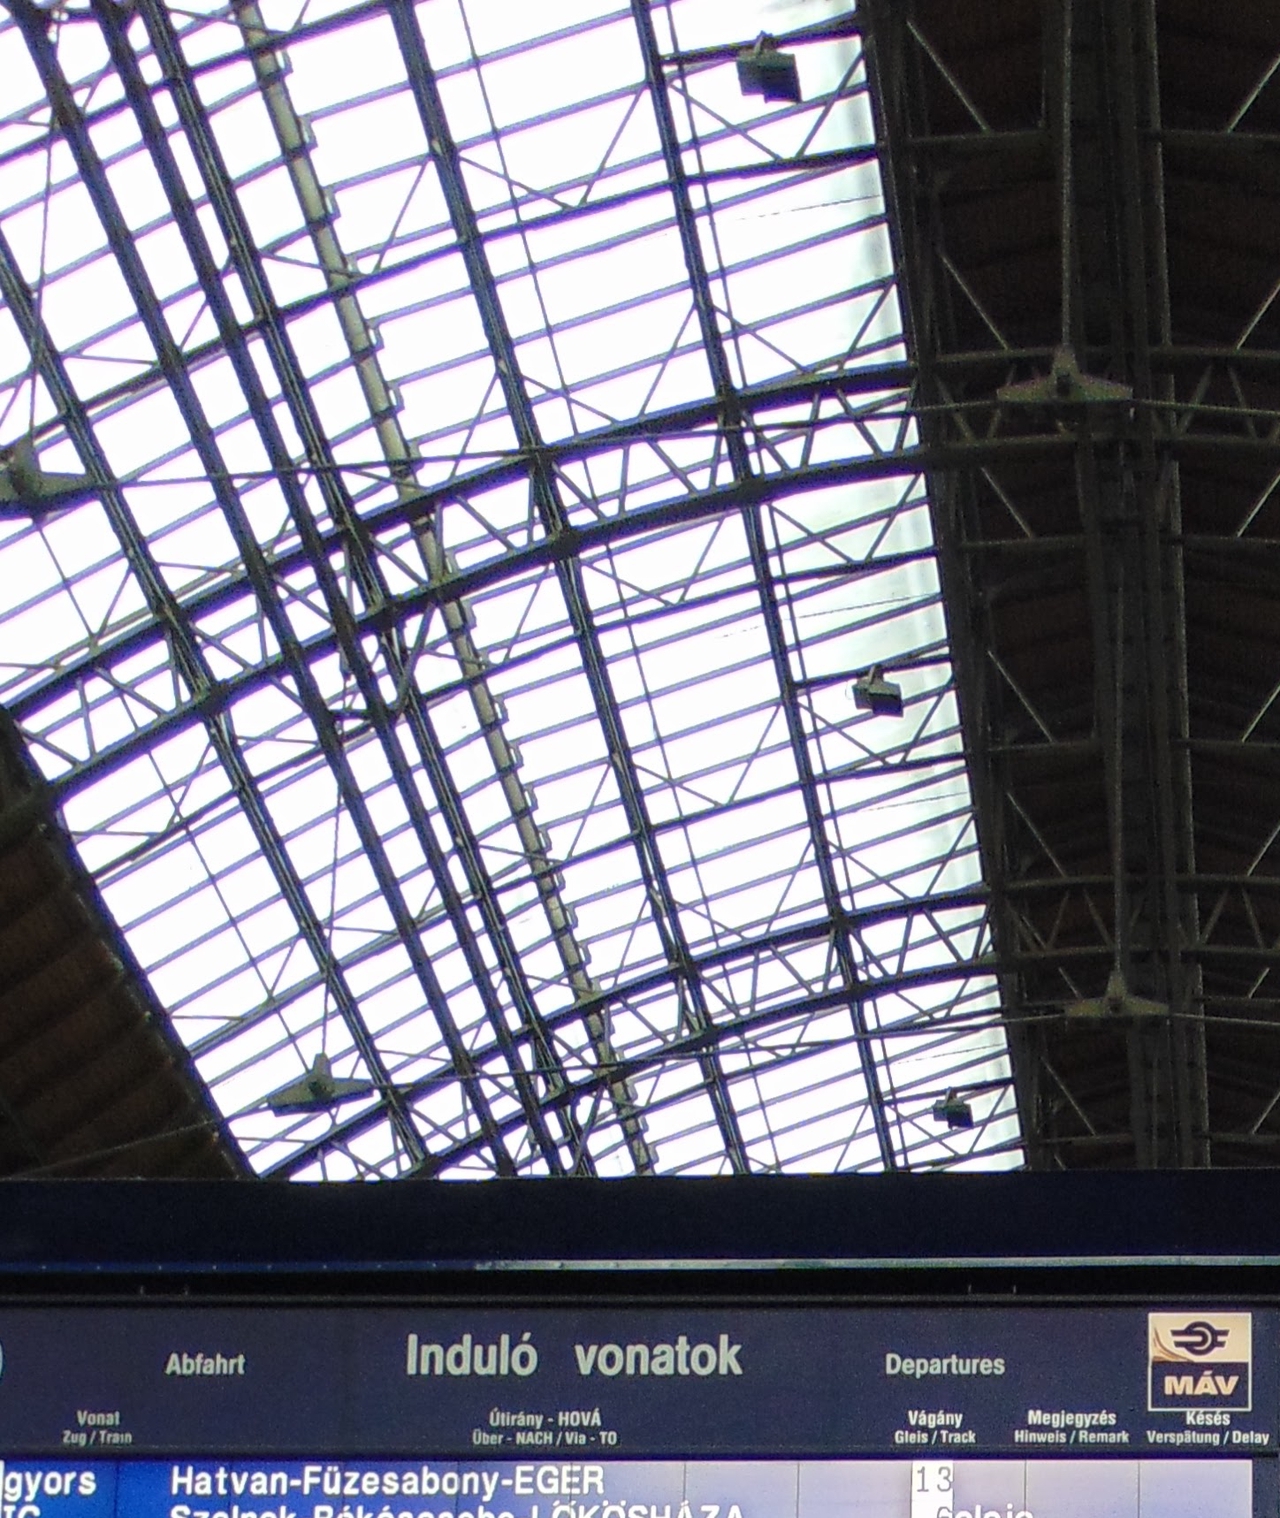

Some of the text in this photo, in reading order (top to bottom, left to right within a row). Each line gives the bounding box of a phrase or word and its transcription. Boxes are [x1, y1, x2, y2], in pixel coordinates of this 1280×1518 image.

[407, 1333, 742, 1376] Induló vonatok
[166, 1353, 246, 1376] Abfahrt
[885, 1353, 1005, 1380] Departures
[1164, 1372, 1238, 1396] MÁV
[77, 1411, 120, 1426] Vonat
[490, 1408, 601, 1428] Útirány HOVÁ
[908, 1411, 963, 1428] Vágány
[1028, 1410, 1116, 1428] Megjegyzés
[1186, 1411, 1230, 1426] Késés
[63, 1430, 132, 1446] Zug Train
[472, 1430, 617, 1445] Über NACH Via TO
[895, 1430, 976, 1444] Gleis Track
[1014, 1430, 1129, 1444] Hinweis Remark
[1146, 1430, 1269, 1446] Verspätung Delay
[171, 1464, 604, 1500] Hatvan-Füzesabony-EGER
